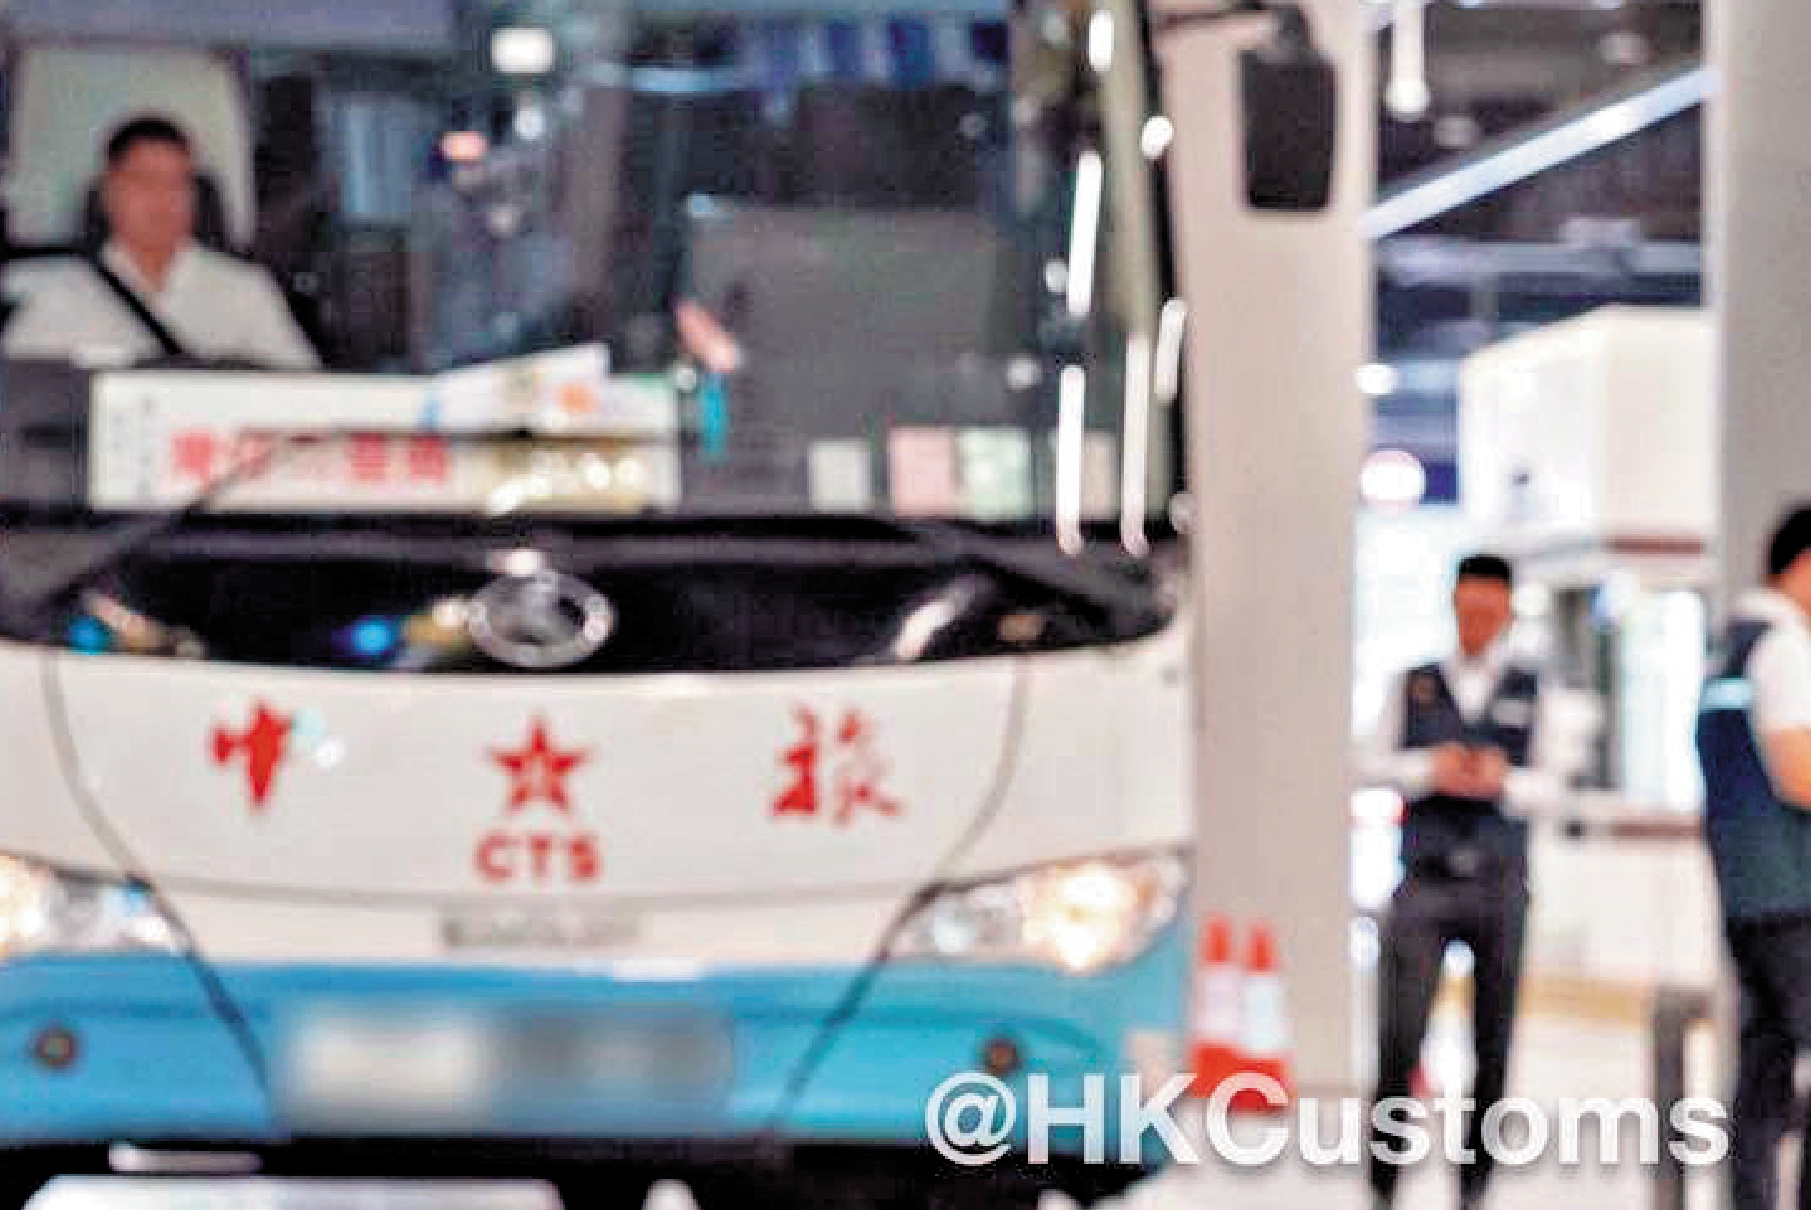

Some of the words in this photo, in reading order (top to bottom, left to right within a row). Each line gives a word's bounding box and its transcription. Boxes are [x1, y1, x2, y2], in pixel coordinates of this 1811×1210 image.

[208, 698, 296, 812] 中
[770, 704, 902, 826] 旅
[475, 832, 600, 882] CTS
